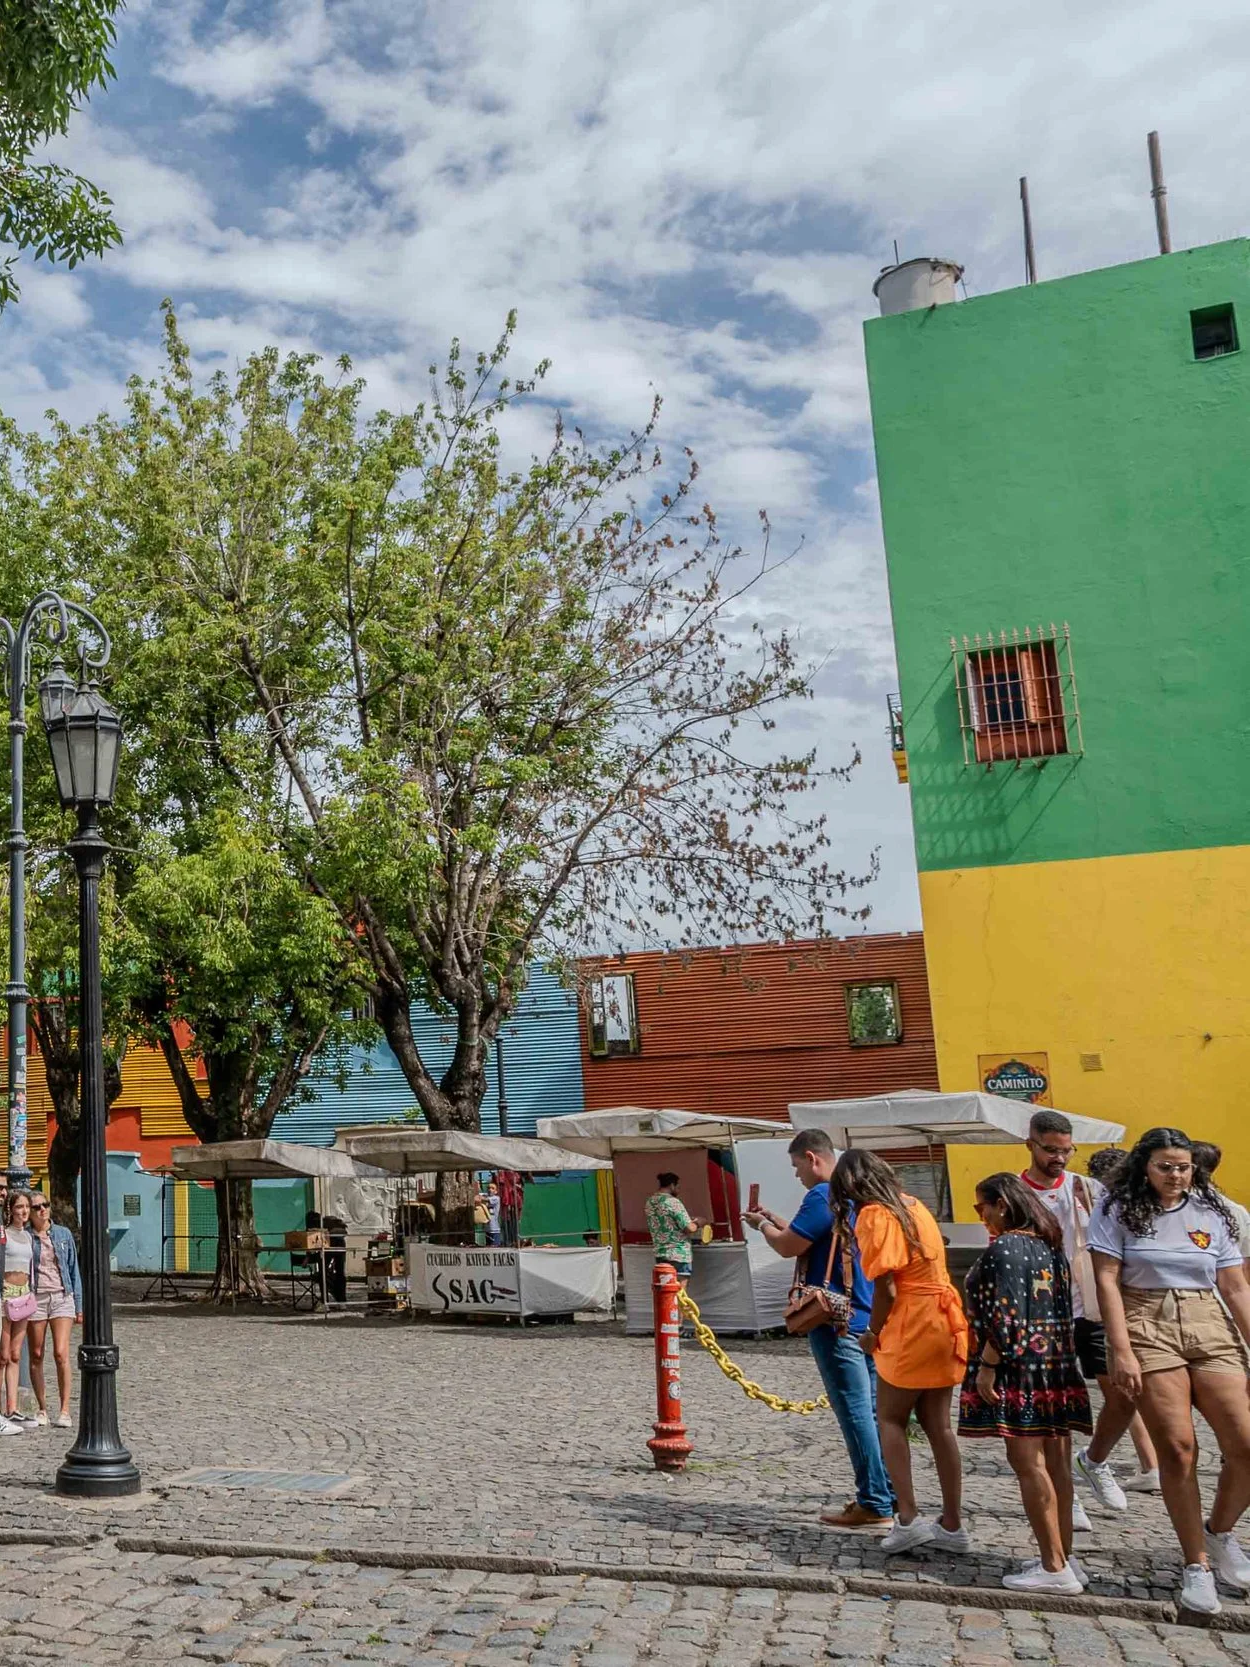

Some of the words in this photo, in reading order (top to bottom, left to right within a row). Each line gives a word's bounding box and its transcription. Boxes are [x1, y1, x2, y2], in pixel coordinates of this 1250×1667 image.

[987, 1078, 1044, 1090] CAMINITO
[426, 1253, 462, 1266] CUCHILLOS
[466, 1253, 490, 1266] KNIVES
[493, 1252, 515, 1266] FACAS
